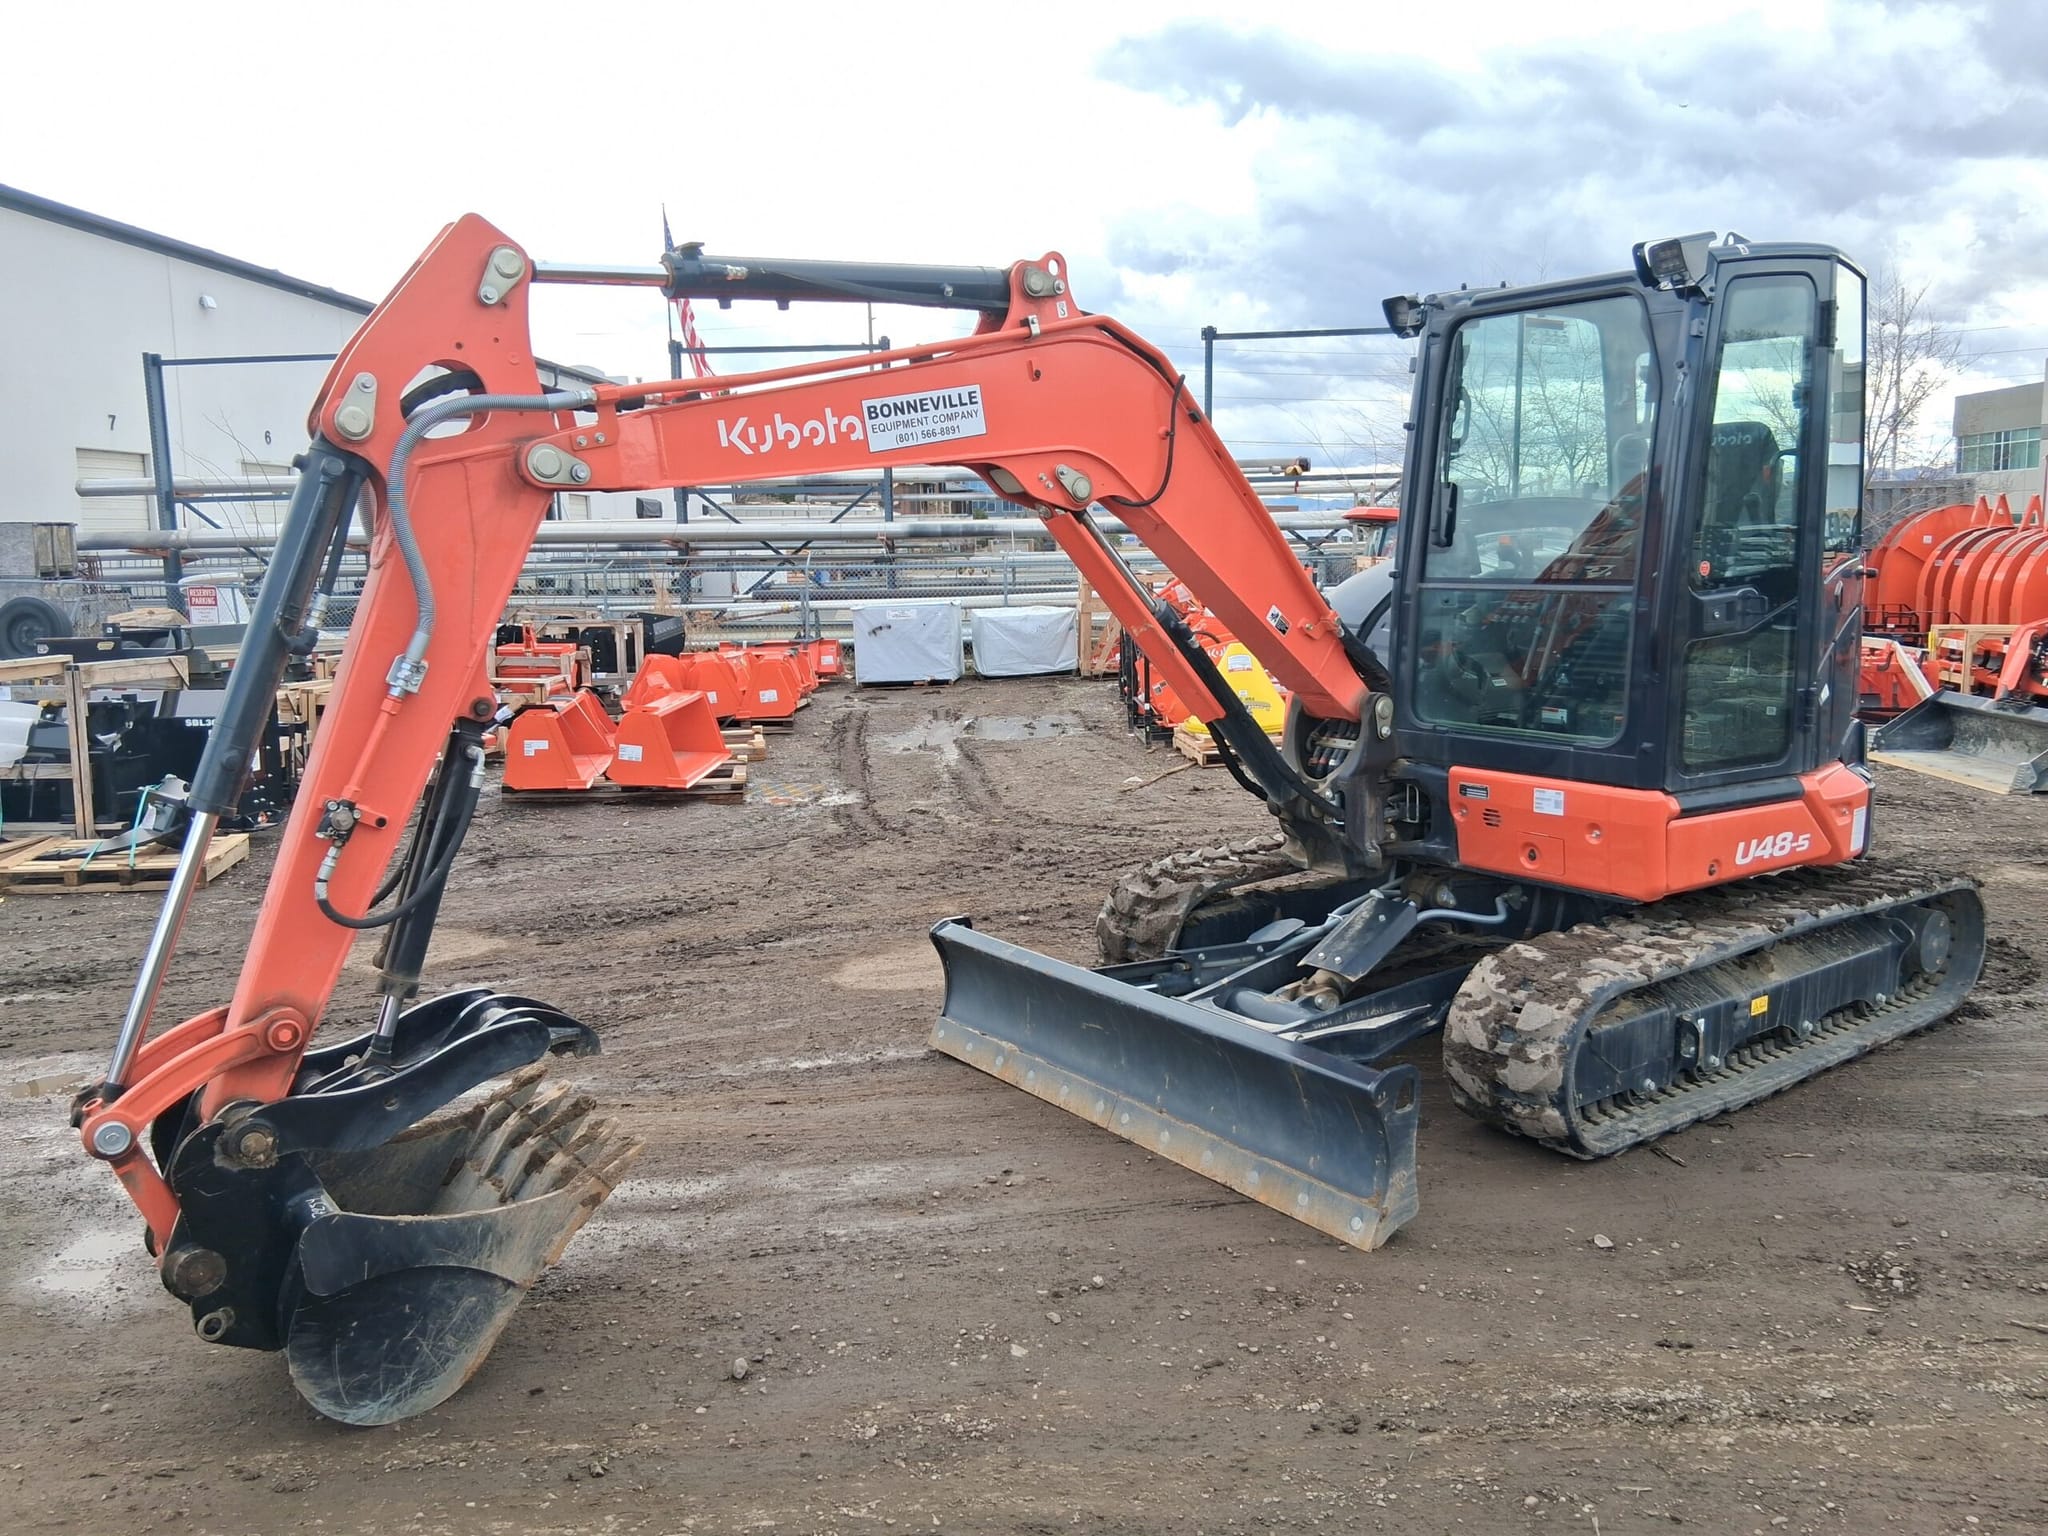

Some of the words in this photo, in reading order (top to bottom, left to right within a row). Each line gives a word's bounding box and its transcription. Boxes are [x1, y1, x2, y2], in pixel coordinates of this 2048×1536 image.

[866, 391, 979, 420] BONNEVILLE
[107, 414, 117, 431] 7
[871, 416, 929, 434] EQUIPMENT
[932, 409, 979, 425] COMPANY
[264, 430, 272, 445] 6
[717, 407, 864, 455] Kubota
[895, 431, 919, 445] (801)
[921, 425, 961, 440] 566-8891
[1711, 431, 1752, 446] ubota
[190, 588, 216, 597] RESERVED
[191, 596, 216, 605] PARKING
[1735, 831, 1811, 865] U48-5
